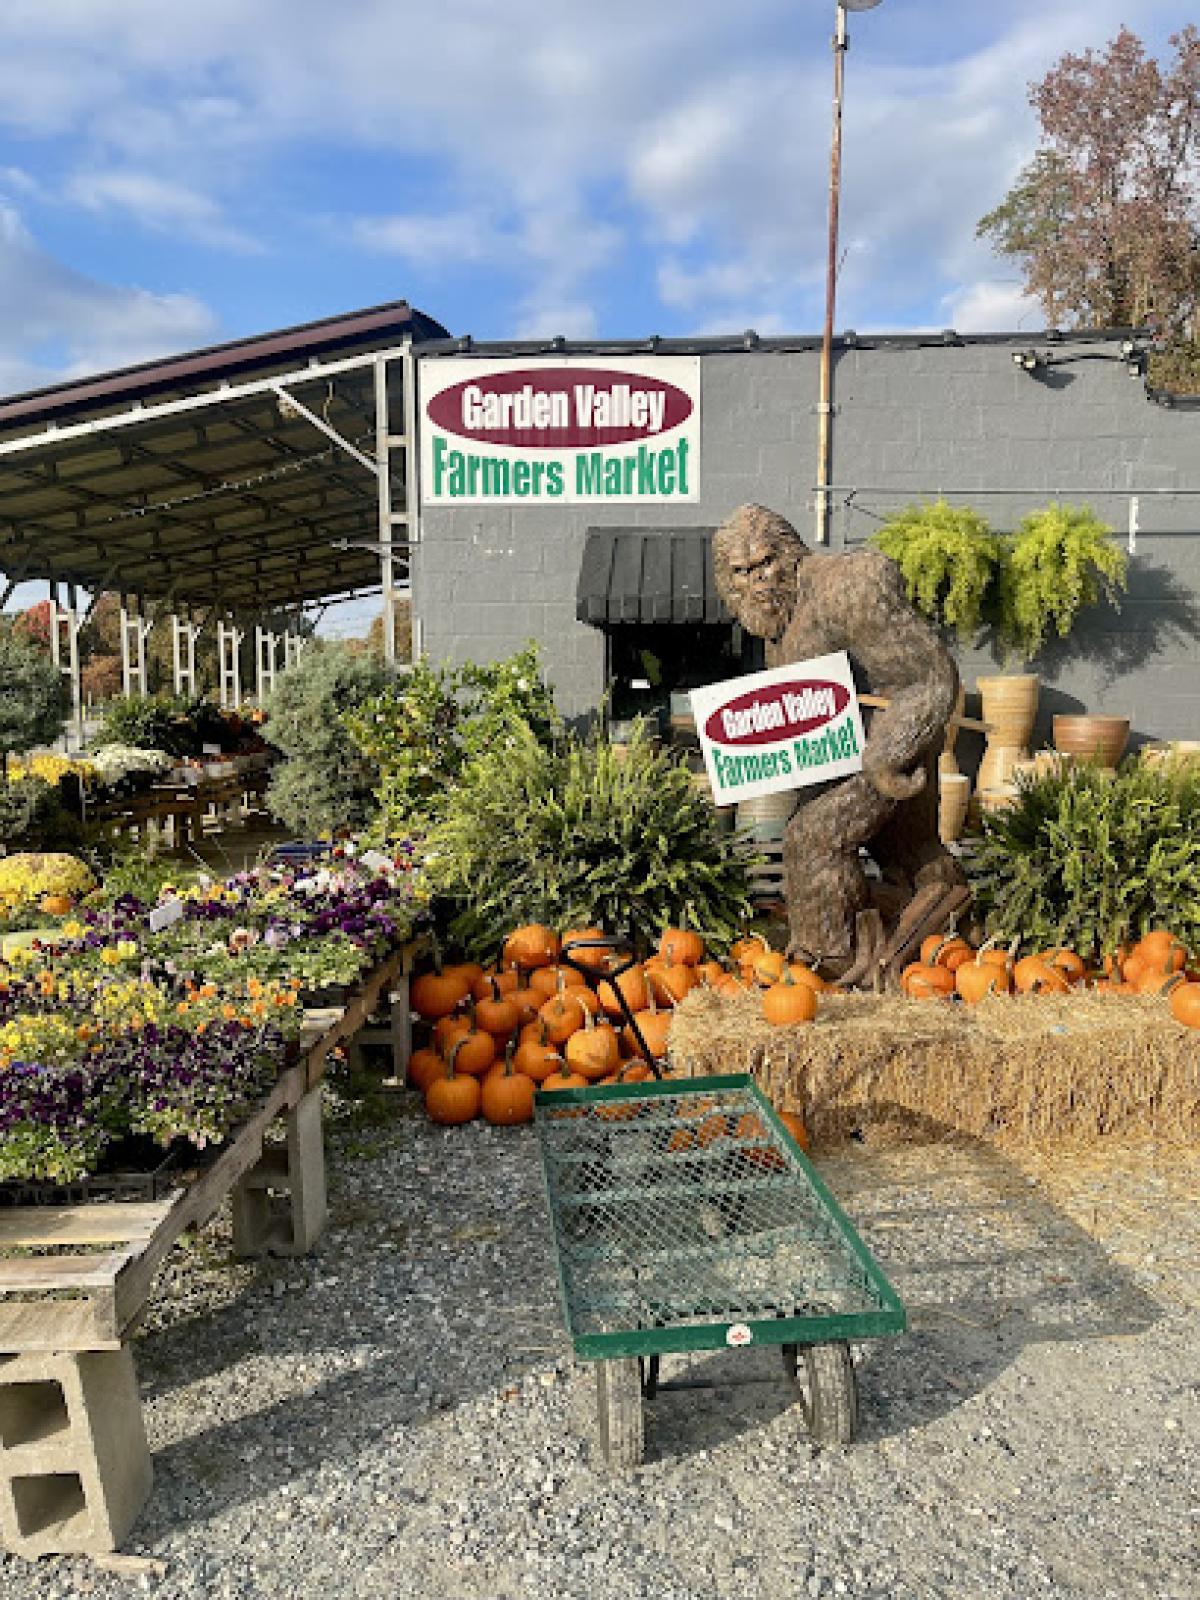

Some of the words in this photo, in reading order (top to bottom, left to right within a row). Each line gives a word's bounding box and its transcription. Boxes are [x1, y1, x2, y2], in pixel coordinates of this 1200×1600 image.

[462, 384, 569, 430] Garden
[573, 384, 666, 433] Valley
[432, 435, 565, 498] Farmers
[575, 437, 689, 495] Market
[721, 700, 785, 739] Garden
[782, 687, 836, 723] Valley
[712, 747, 792, 789] Farmers
[793, 717, 860, 771] Market
